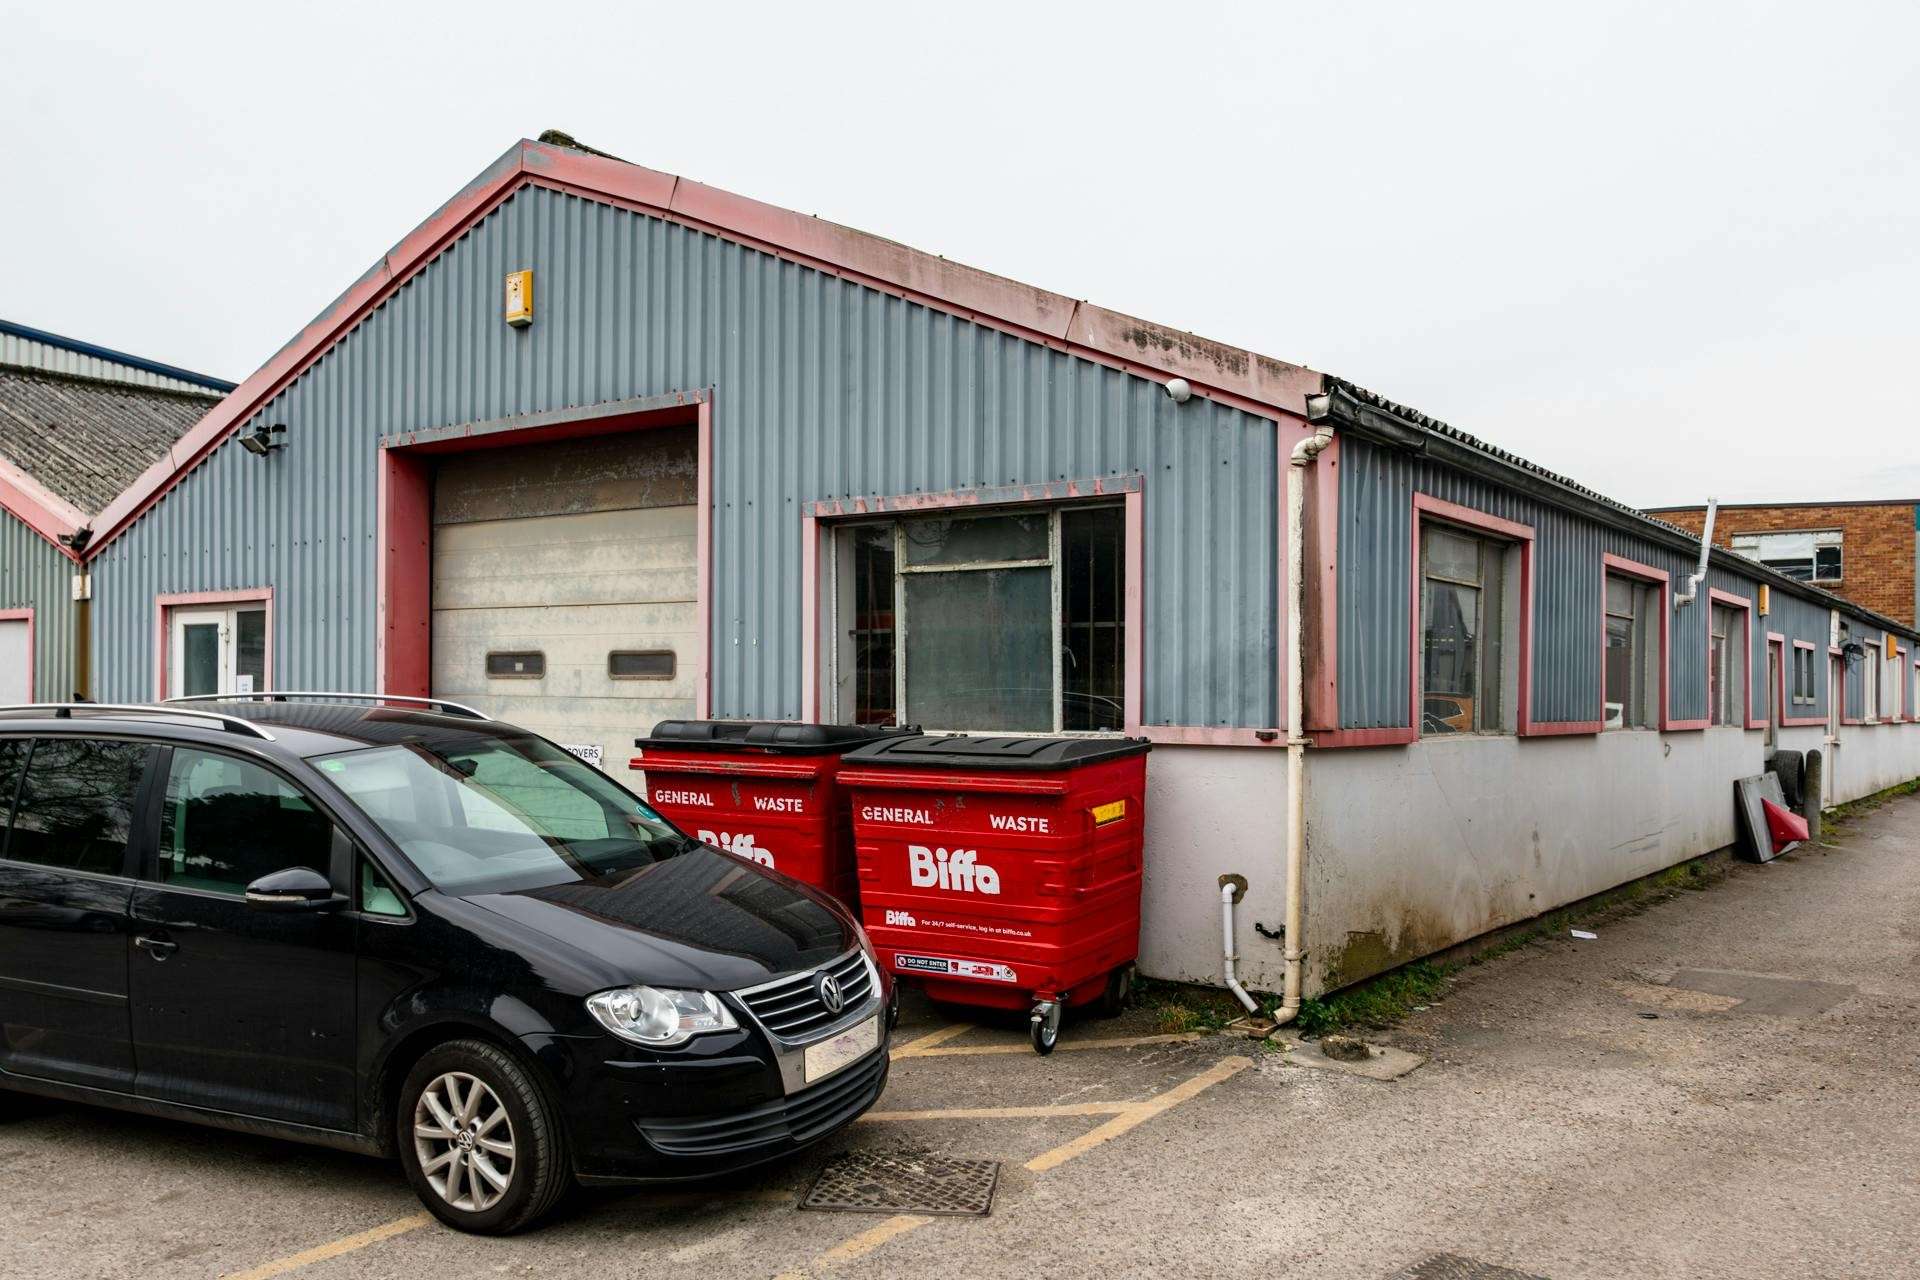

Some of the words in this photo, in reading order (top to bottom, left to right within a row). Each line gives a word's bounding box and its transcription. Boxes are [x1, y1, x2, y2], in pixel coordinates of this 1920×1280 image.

[566, 747, 599, 759] OVERS
[655, 789, 714, 807] GENERAL
[753, 796, 803, 813] WASTE
[862, 806, 934, 825] GENERAL
[989, 814, 1049, 833] WASTE
[908, 845, 1001, 895] Biffa
[886, 909, 916, 927] Biffa
[931, 920, 945, 928] 24/7
[945, 922, 978, 931] self-service,
[1002, 928, 1032, 937] biffa.co.uk
